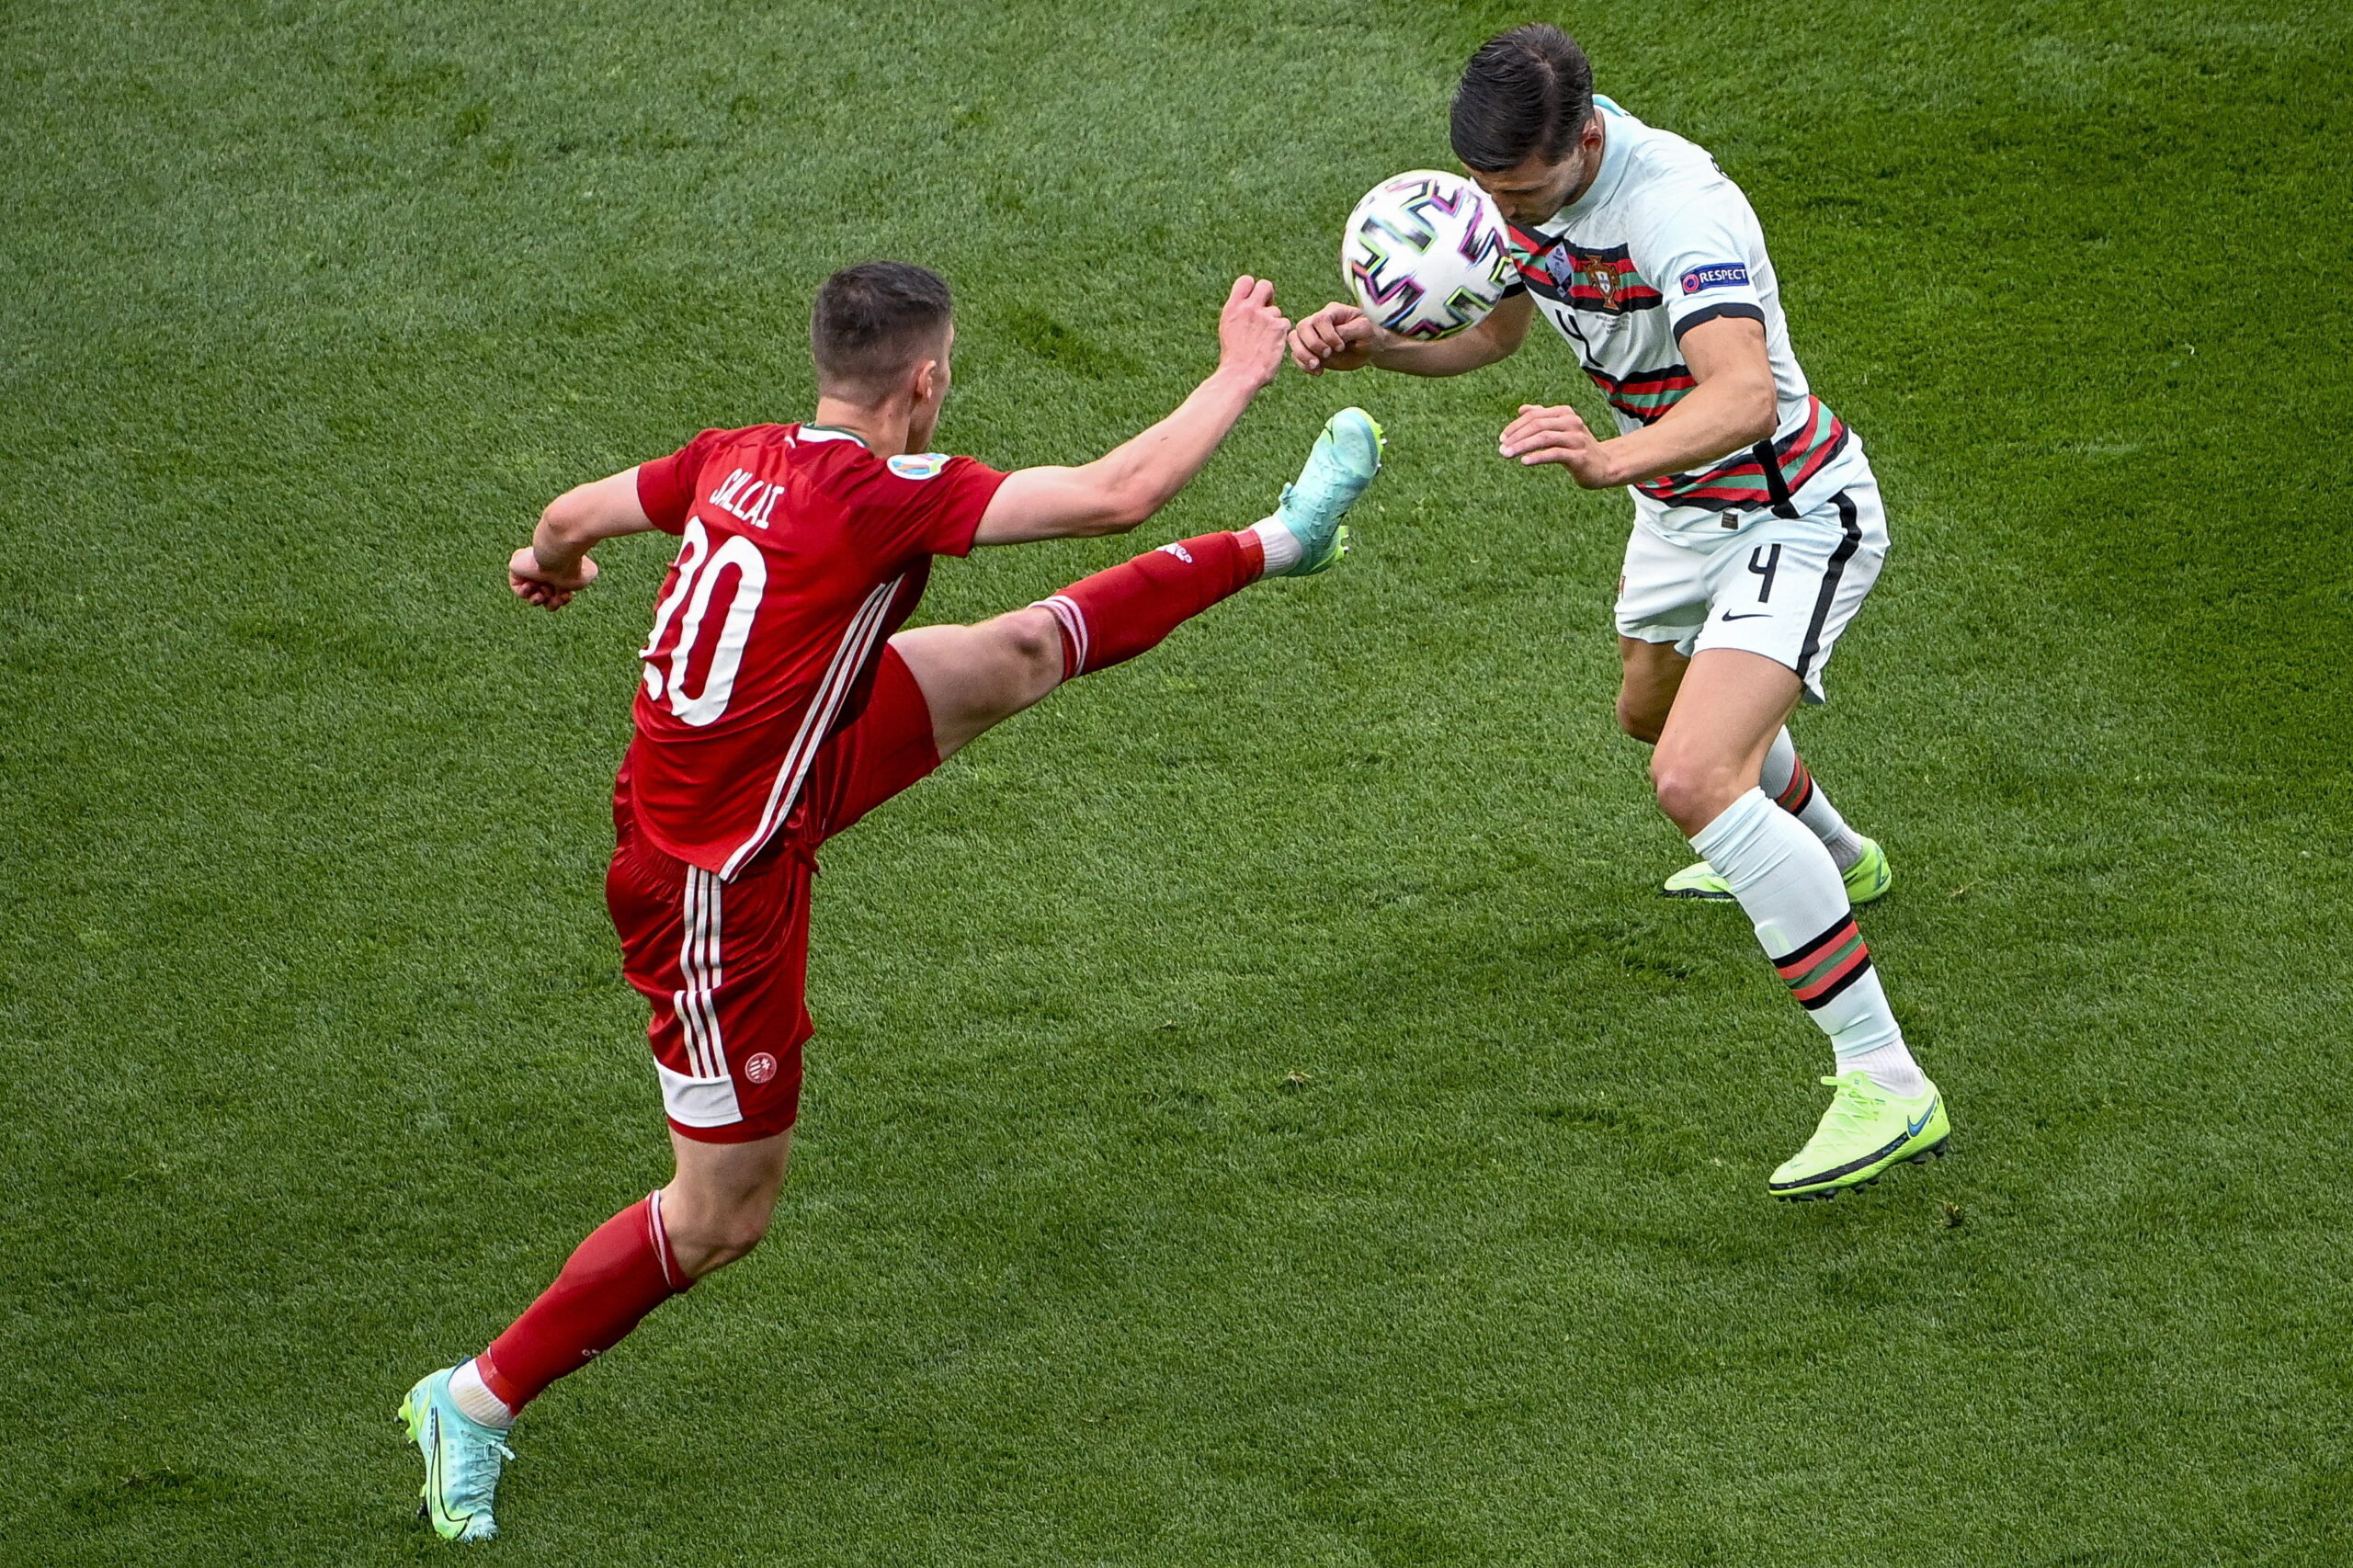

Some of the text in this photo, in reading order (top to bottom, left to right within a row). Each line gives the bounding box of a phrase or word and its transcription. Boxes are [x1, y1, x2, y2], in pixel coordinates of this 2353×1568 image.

[1699, 268, 1746, 284] RESPECT
[1554, 308, 1605, 369] 4
[709, 468, 785, 530] SALLAI
[1747, 542, 1782, 604] 4
